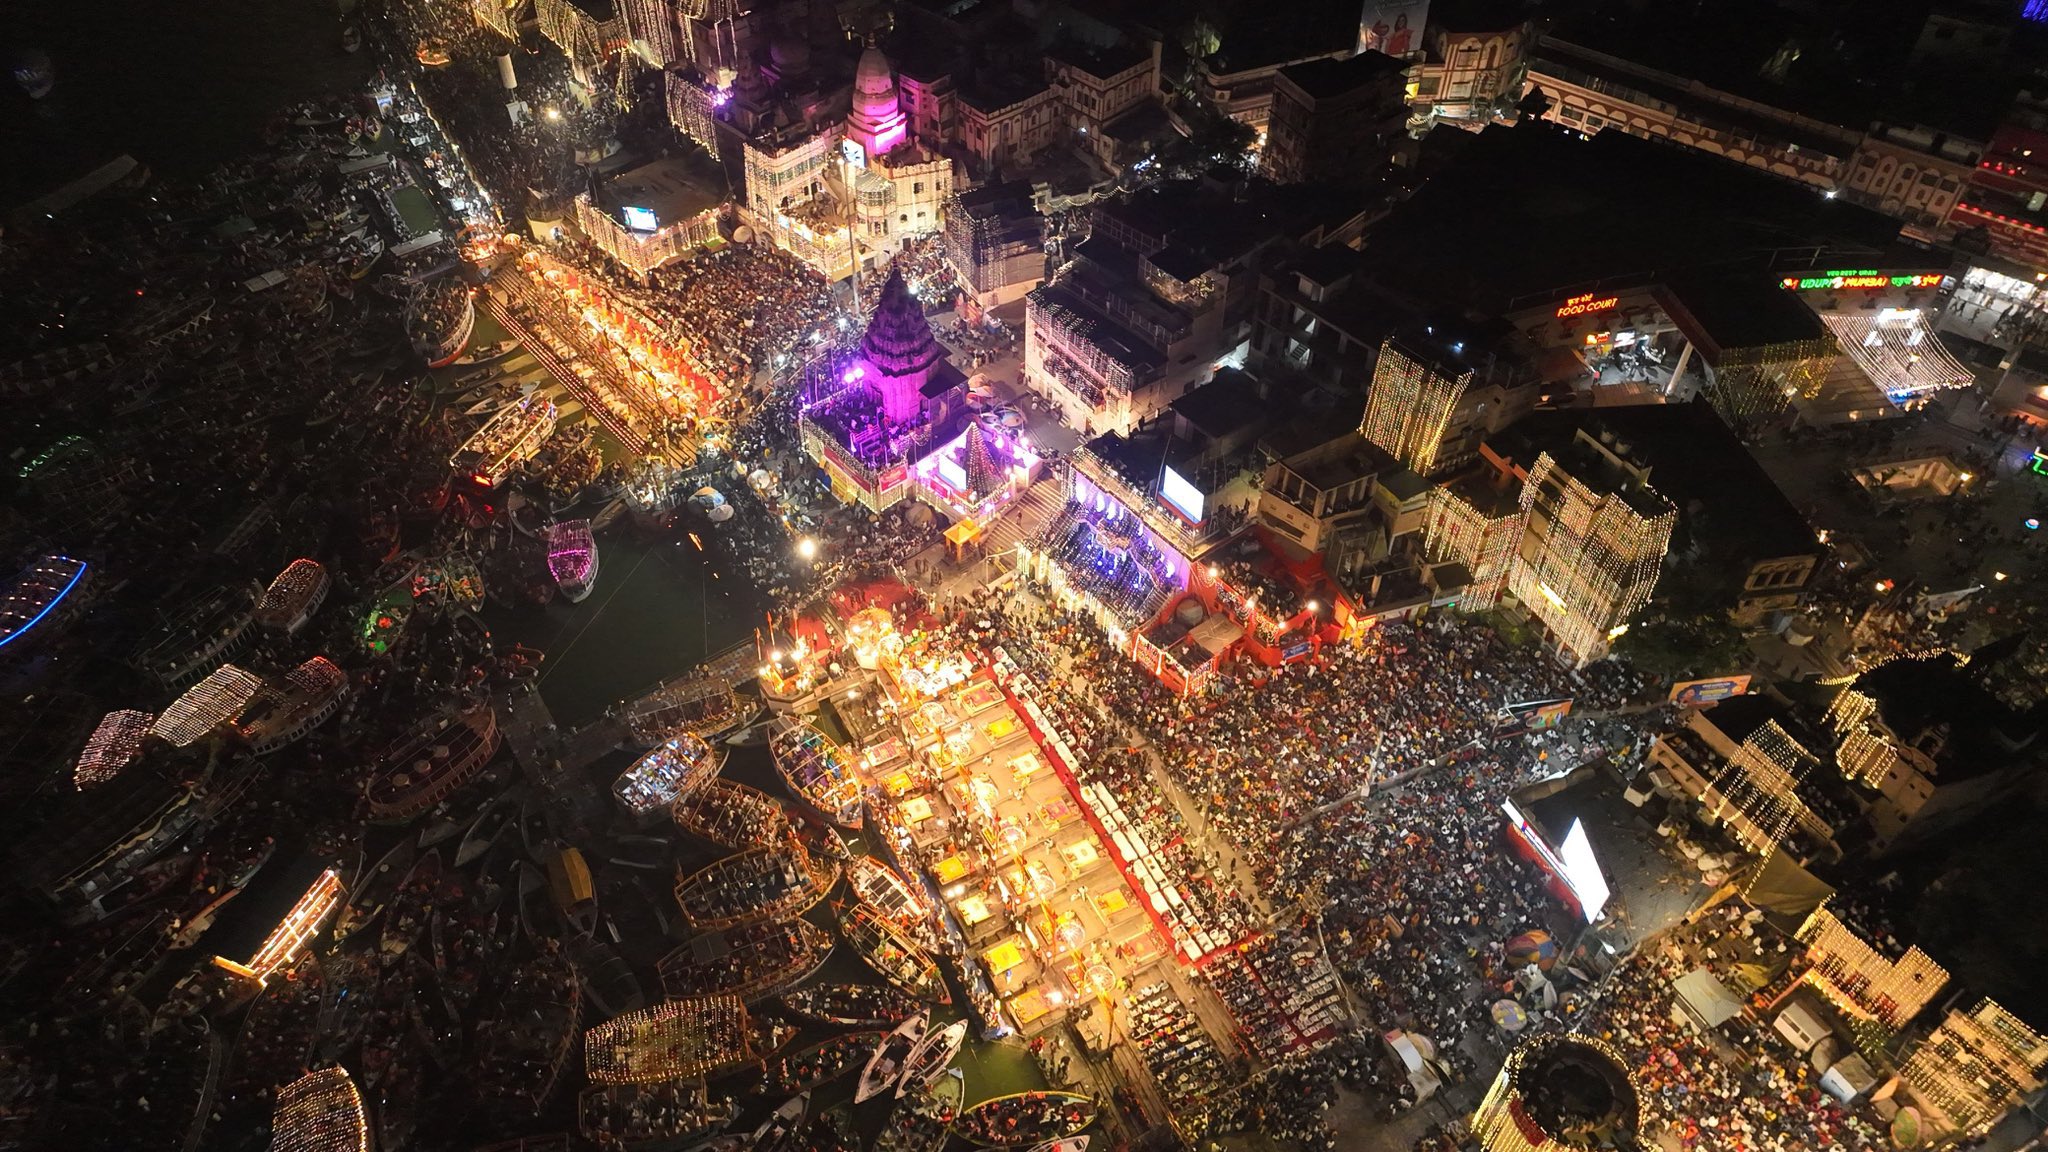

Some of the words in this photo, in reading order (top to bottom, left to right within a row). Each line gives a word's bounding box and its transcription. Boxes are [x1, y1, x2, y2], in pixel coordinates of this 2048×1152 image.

[1801, 278, 1833, 289] UDUPI
[1844, 276, 1888, 288] MUMBAI
[1557, 304, 1585, 317] FOOD
[1586, 297, 1618, 311] COURT
